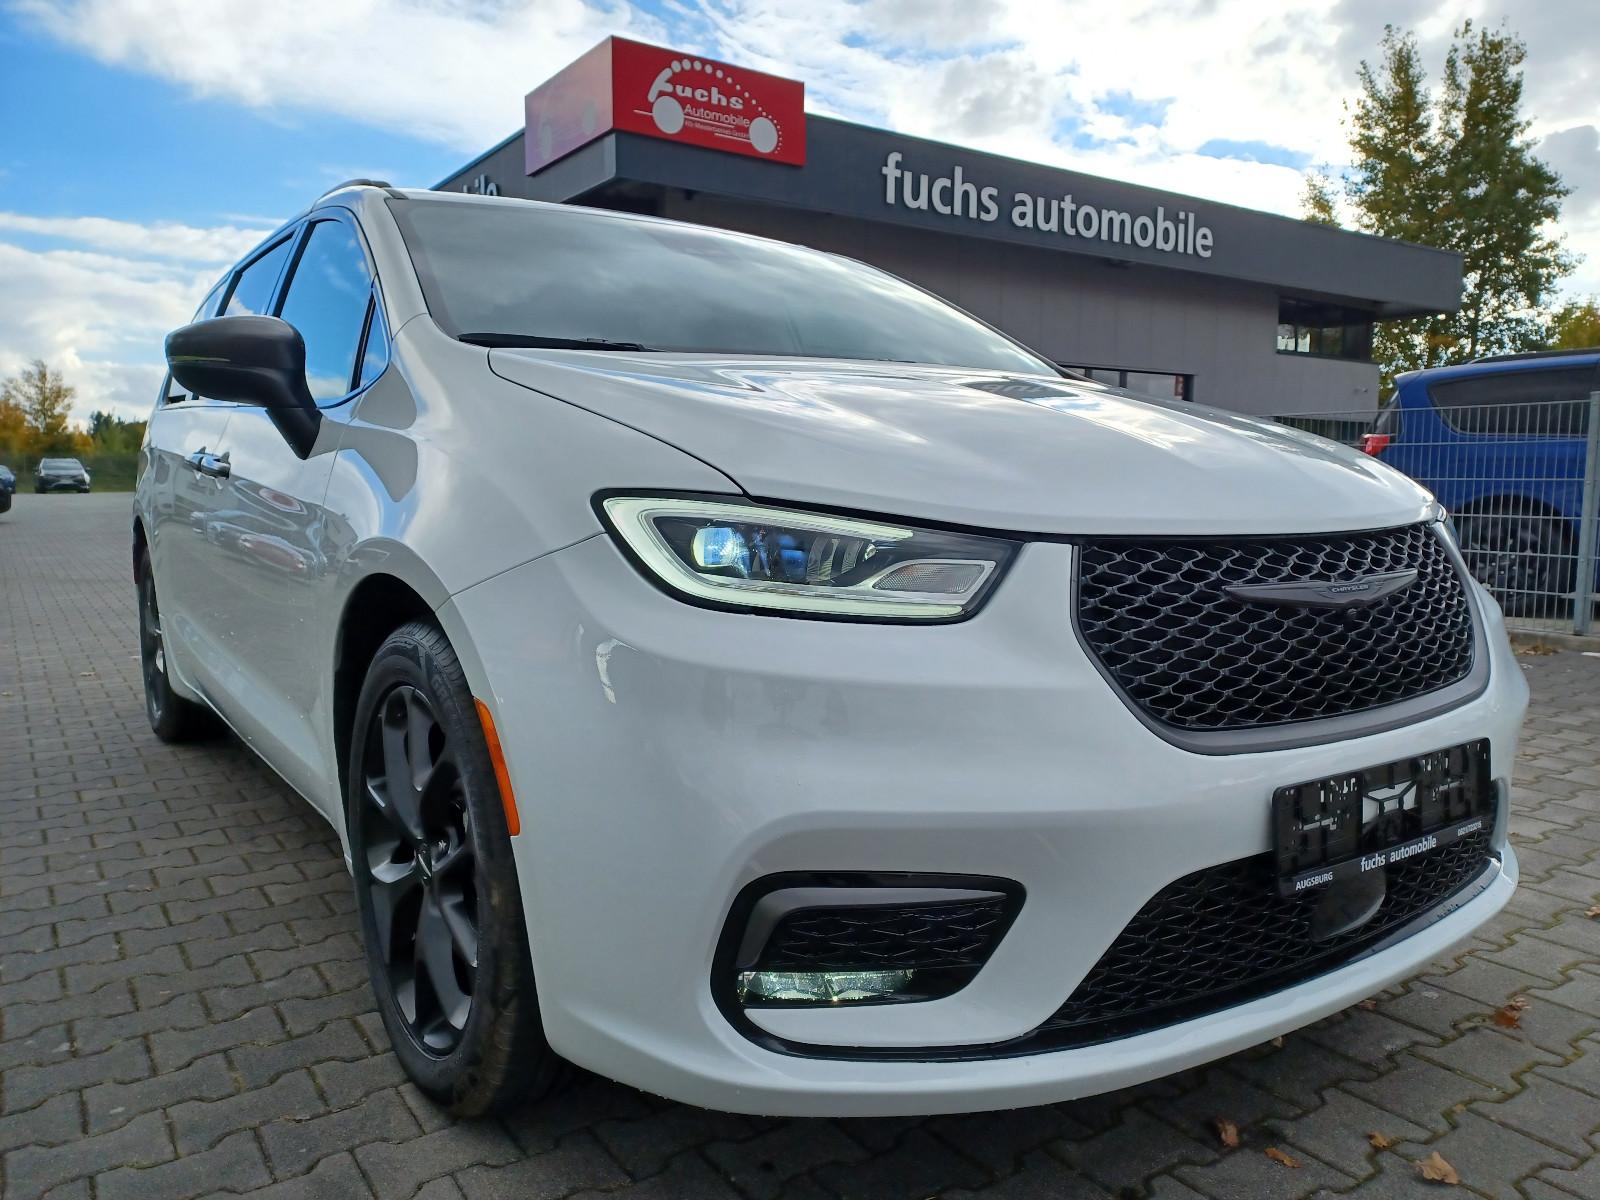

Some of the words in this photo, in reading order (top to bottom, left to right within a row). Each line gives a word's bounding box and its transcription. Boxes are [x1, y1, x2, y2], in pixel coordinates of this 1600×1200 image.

[685, 104, 750, 127] Automobile
[882, 152, 999, 222] fuchs
[1012, 192, 1213, 257] automobile
[1360, 854, 1386, 872] fuchs
[1389, 835, 1437, 863] automobile
[1295, 871, 1333, 890] AUGSBURG
